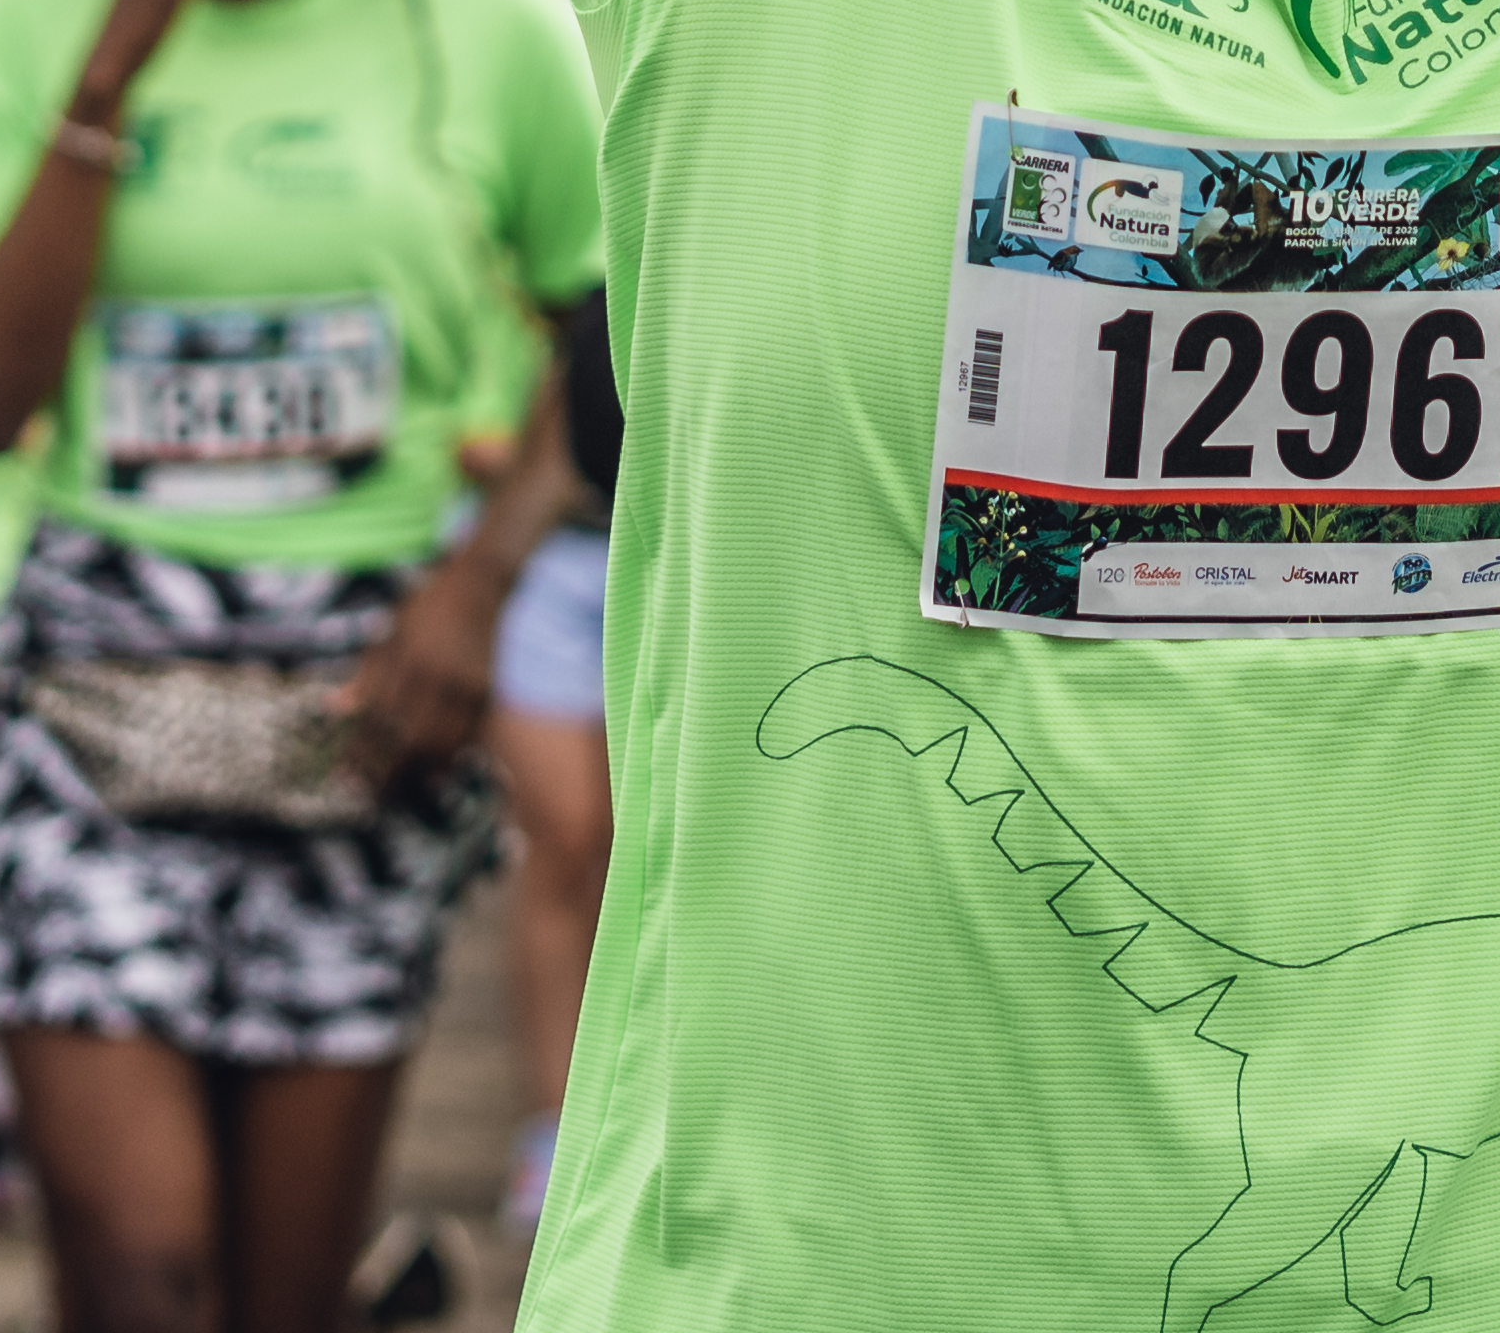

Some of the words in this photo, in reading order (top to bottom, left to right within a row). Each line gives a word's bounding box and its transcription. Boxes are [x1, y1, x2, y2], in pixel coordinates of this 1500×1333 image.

[1189, 26, 1267, 69] NATURA
[1337, 188, 1421, 203] CARRERA
[1012, 208, 1038, 219] VERDE
[1107, 203, 1172, 221] Fundación
[1337, 202, 1421, 222] VERDE
[1099, 212, 1170, 236] Natura
[1109, 231, 1169, 248] Colombia
[1284, 238, 1329, 249] PARQUE
[958, 361, 969, 392] 12967
[1195, 566, 1257, 581] CRISTAL
